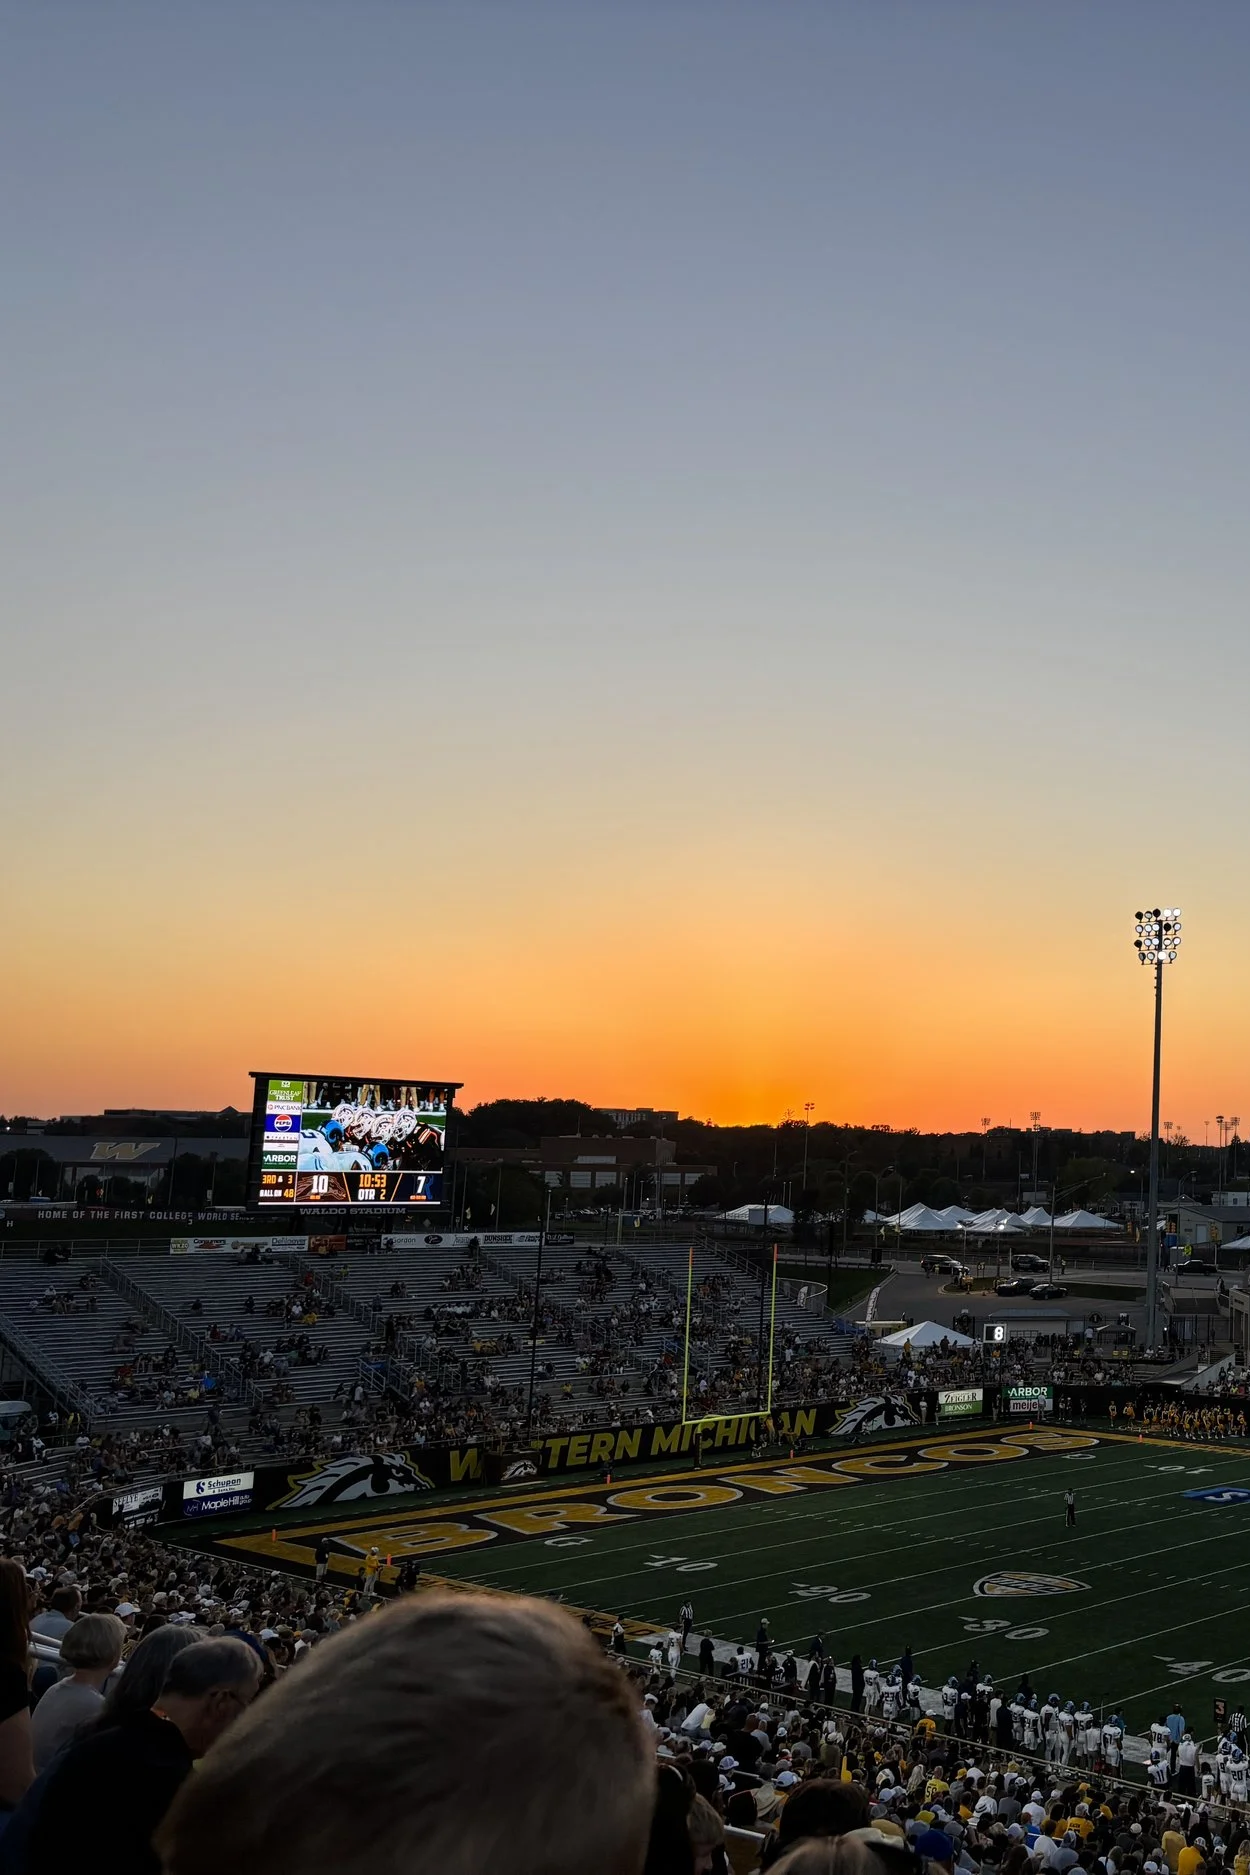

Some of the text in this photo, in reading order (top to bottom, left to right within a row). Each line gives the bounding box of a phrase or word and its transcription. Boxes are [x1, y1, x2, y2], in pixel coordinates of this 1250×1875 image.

[264, 1154, 297, 1163] ARBOR
[262, 1174, 277, 1185] 3RD
[287, 1174, 293, 1185] 3
[311, 1174, 329, 1194] 10
[359, 1174, 387, 1188] 10:53
[416, 1175, 426, 1194] 7
[283, 1188, 294, 1198] 48
[379, 1189, 386, 1200] 2
[38, 1210, 67, 1219] HOME
[72, 1210, 86, 1219] OF
[90, 1210, 110, 1219] THE
[114, 1211, 144, 1219] FIRST
[149, 1211, 193, 1220] COLLEGE
[198, 1211, 228, 1221] WORLD
[299, 1207, 407, 1215] WALDO STADIUM
[994, 1326, 1004, 1341] 8
[945, 1392, 977, 1403] ZEIGLER
[1008, 1387, 1048, 1397] ARBOR
[944, 1403, 973, 1412] BRONSON
[450, 1428, 641, 1482] WTERN
[207, 1478, 242, 1489] Schupan
[328, 1432, 1100, 1559] BRONCOS
[1215, 1701, 1225, 1715] 3
